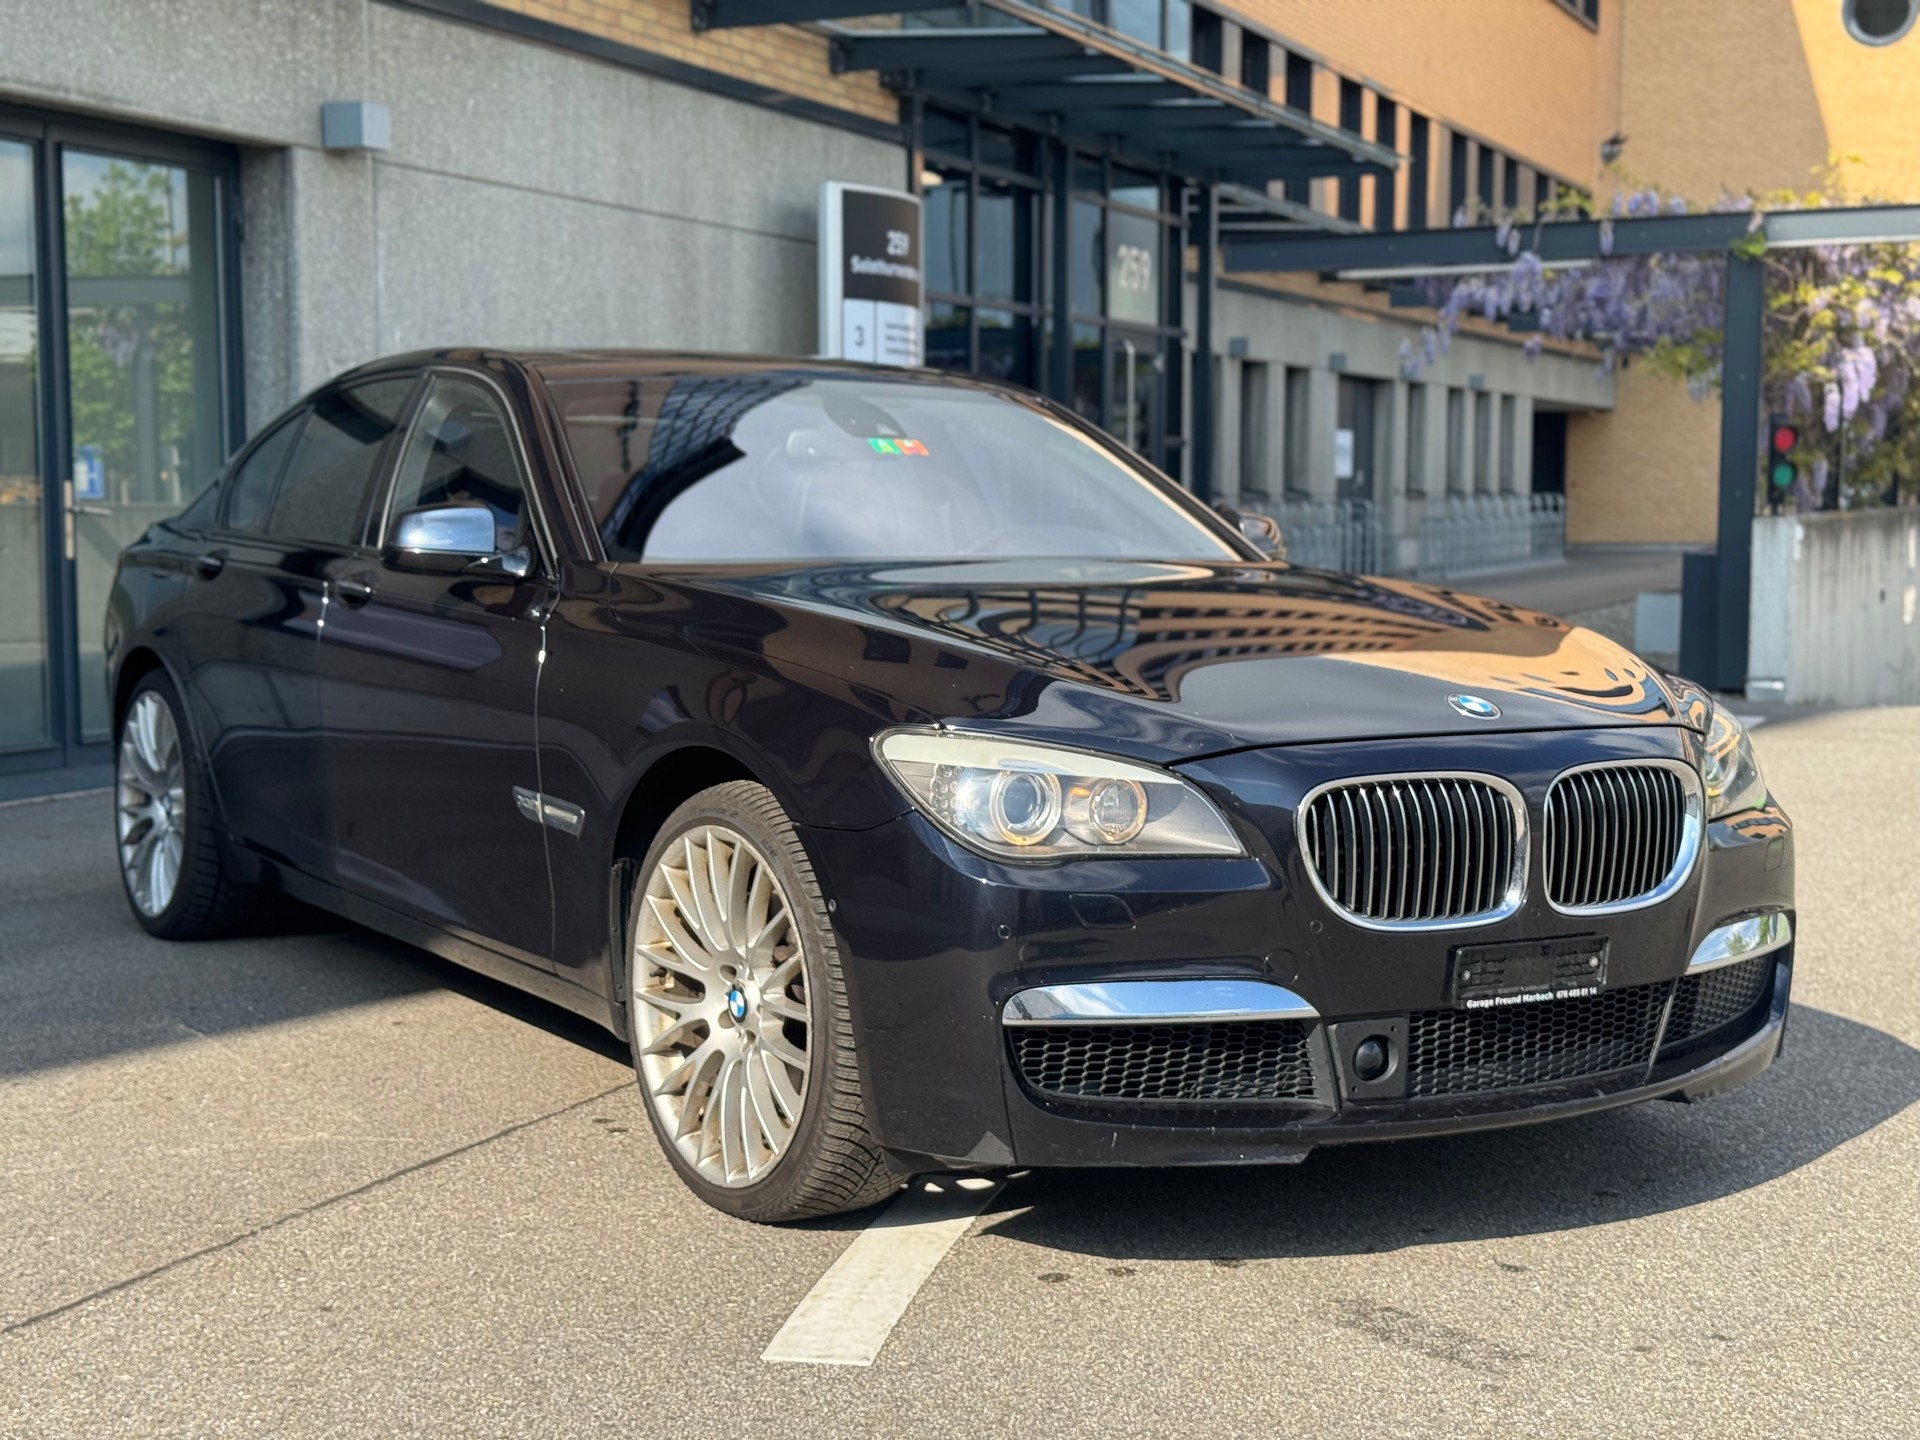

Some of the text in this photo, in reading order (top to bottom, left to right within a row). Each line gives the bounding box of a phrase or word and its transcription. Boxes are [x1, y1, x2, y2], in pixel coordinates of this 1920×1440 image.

[886, 230, 910, 257] 259
[1117, 244, 1152, 293] 259
[855, 325, 865, 347] 3
[1466, 999, 1494, 1009] Garage
[1495, 995, 1521, 1006] Freund
[1522, 991, 1554, 1003] Marbach
